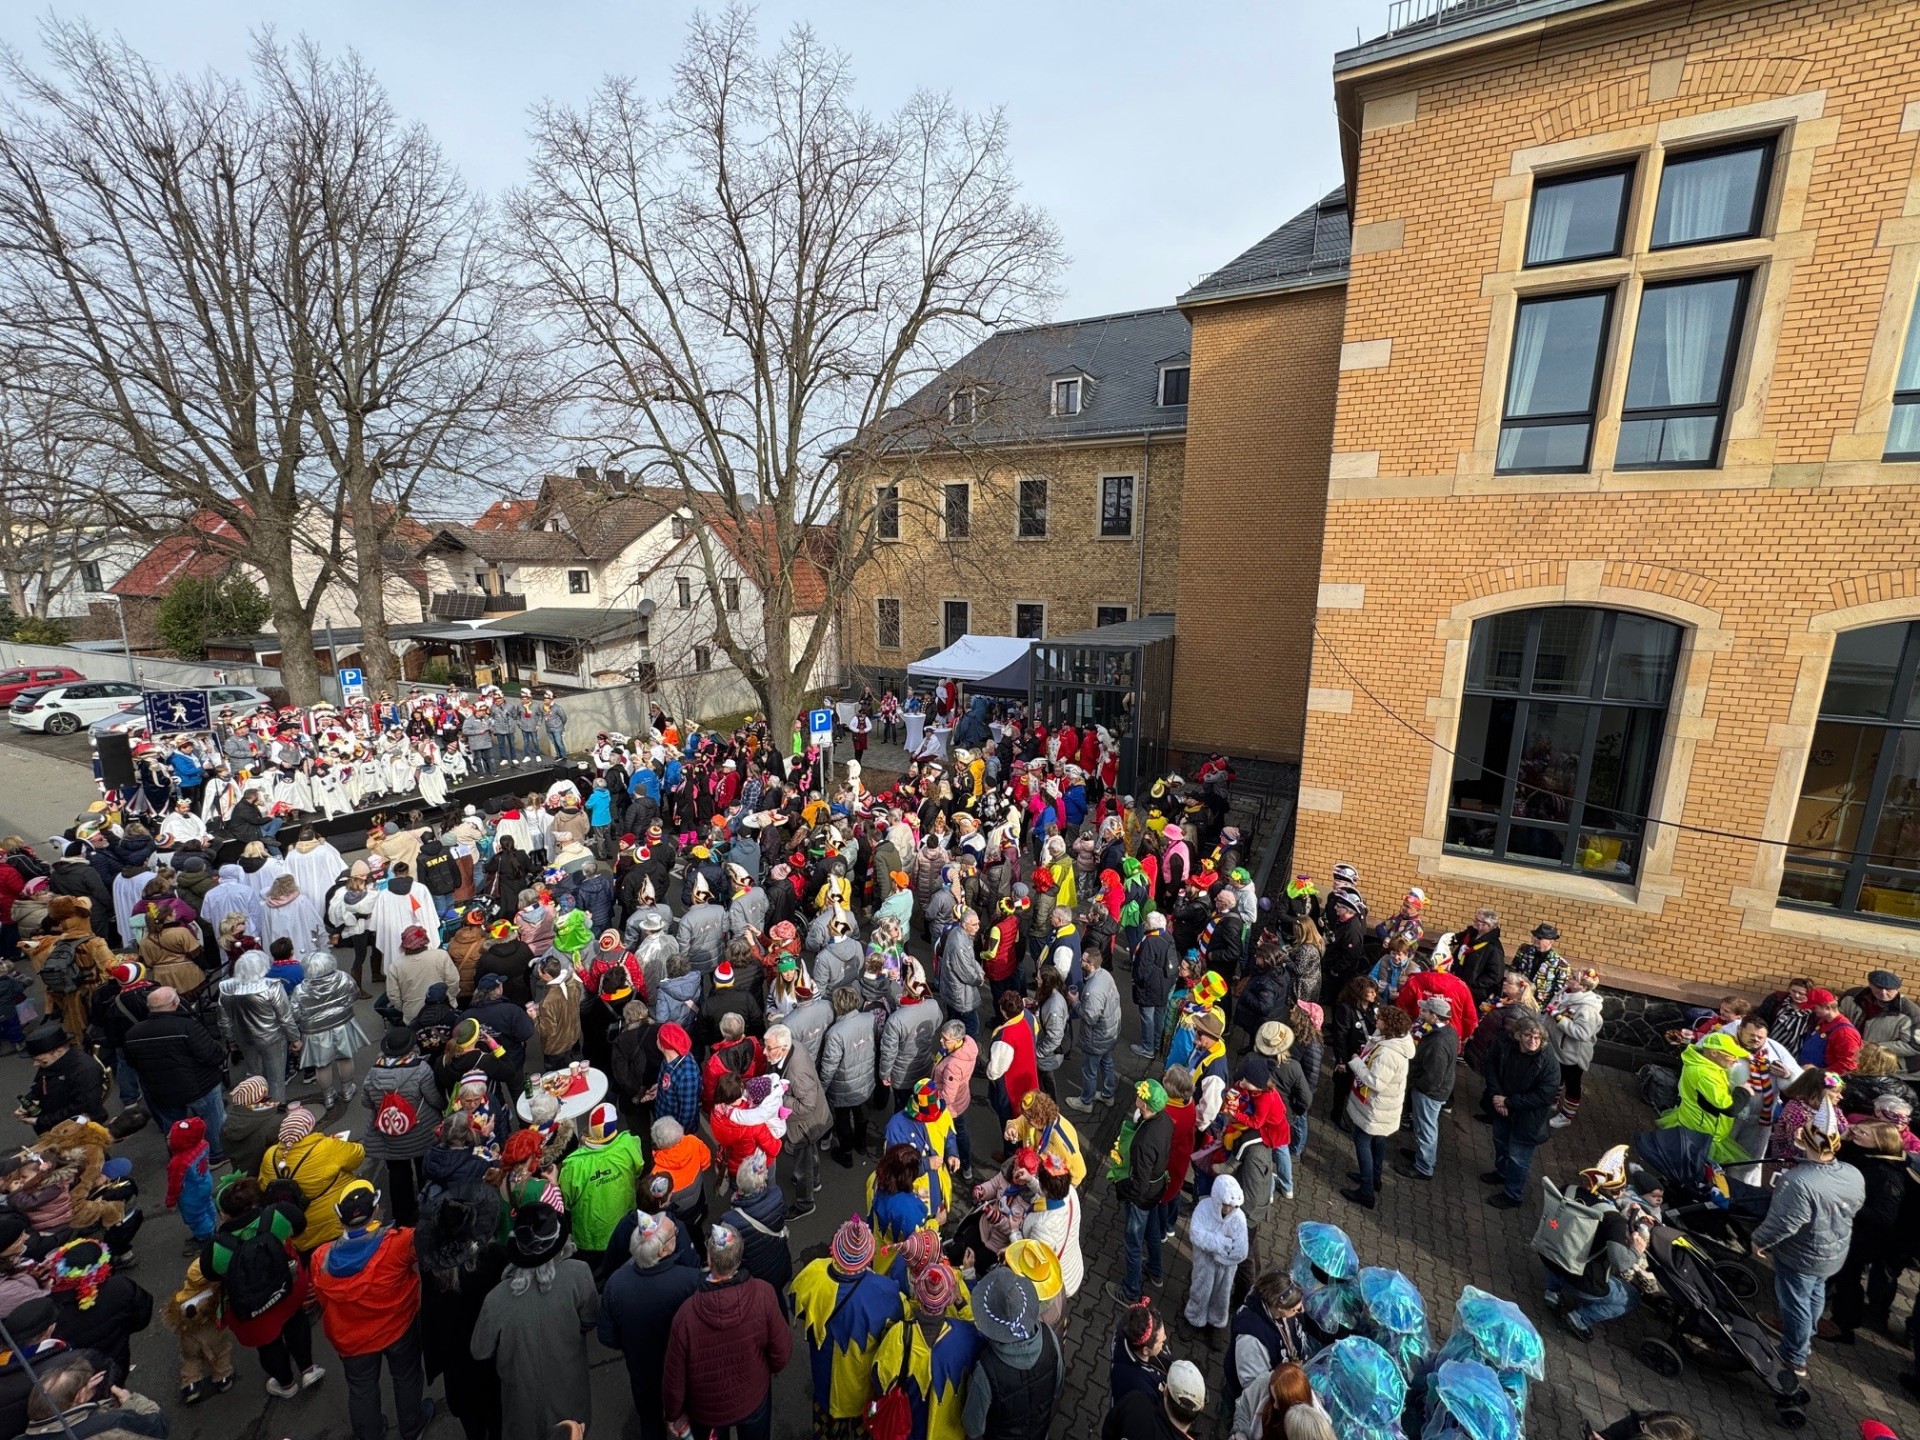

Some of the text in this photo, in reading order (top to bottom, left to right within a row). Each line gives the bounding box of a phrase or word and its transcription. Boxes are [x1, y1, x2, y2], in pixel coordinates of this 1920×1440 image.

[345, 671, 357, 685] P
[815, 713, 826, 730] P
[425, 854, 448, 867] SWAT
